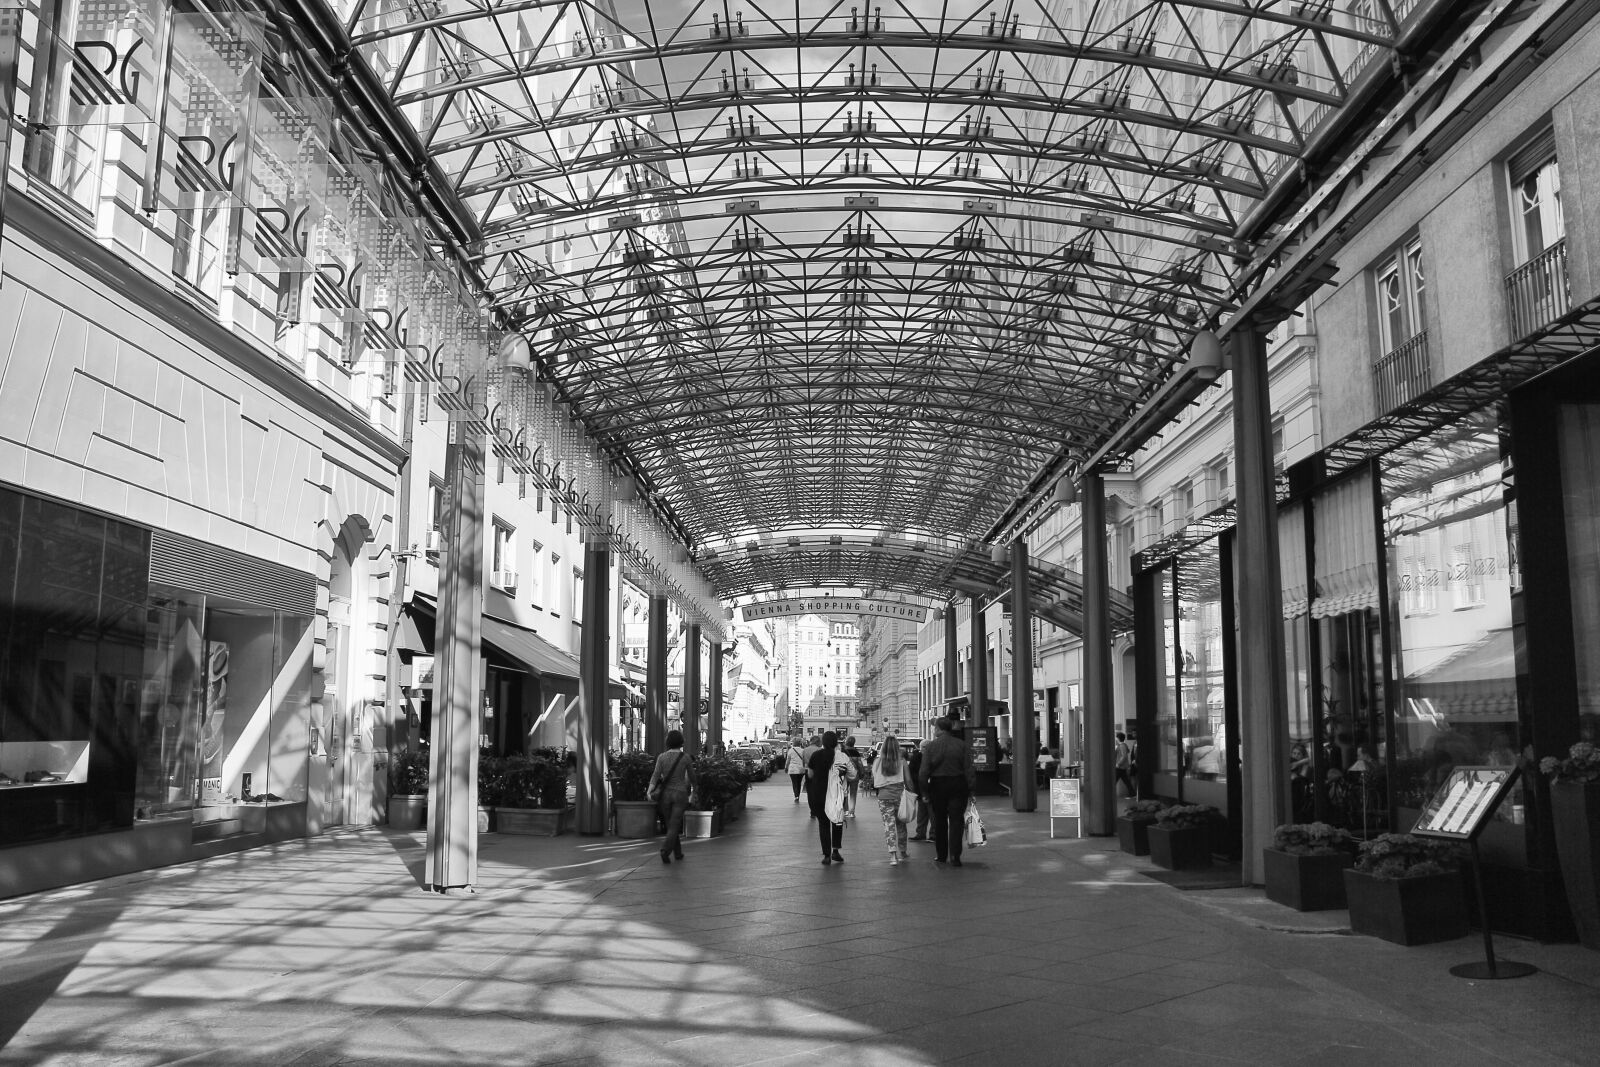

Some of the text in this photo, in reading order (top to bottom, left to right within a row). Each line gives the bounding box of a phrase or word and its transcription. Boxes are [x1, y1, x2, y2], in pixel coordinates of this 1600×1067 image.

[70, 37, 143, 105] RG
[747, 602, 921, 618] VIENNA SHOPPING CULTURE
